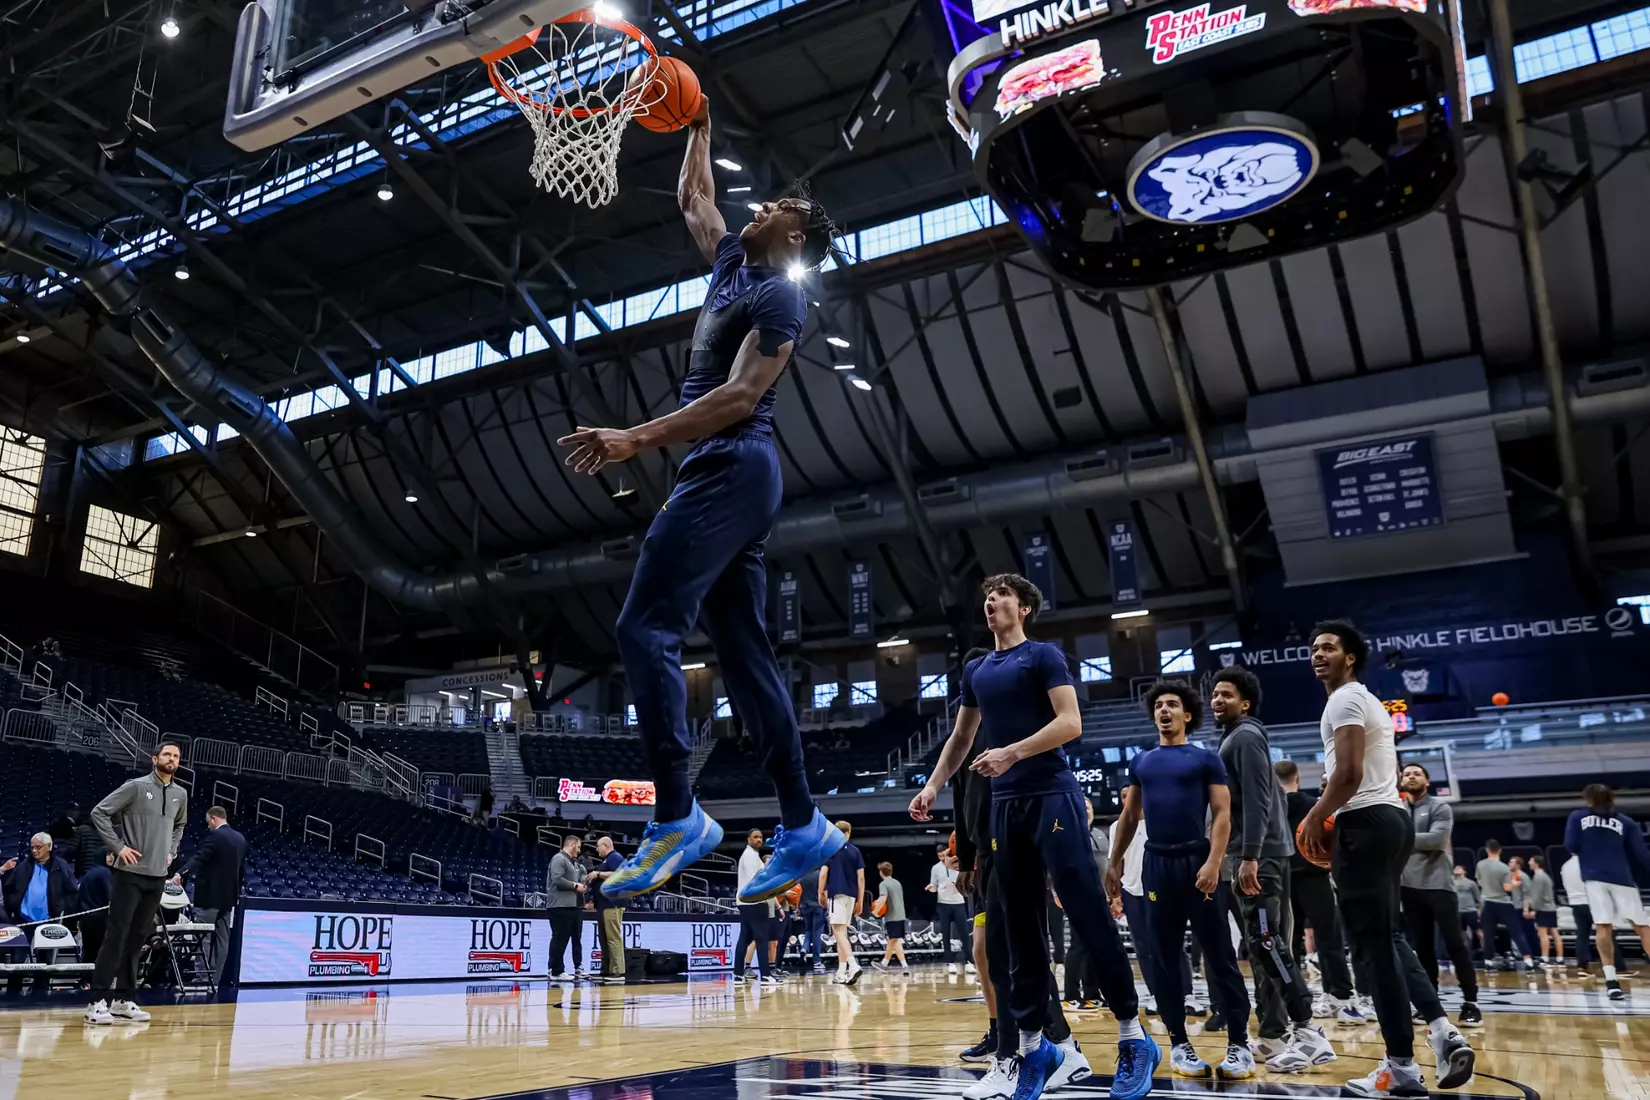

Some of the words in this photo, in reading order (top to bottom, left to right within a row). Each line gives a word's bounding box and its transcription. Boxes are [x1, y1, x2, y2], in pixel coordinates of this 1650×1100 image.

[1149, 7, 1207, 45] PENN
[1157, 9, 1243, 61] STATION
[1202, 27, 1234, 44] COAST
[1377, 631, 1450, 652] HINKLE
[1456, 616, 1599, 645] FIELDHOUSE
[442, 671, 509, 687] CONCESSIONS
[82, 735, 99, 747] 206
[1581, 815, 1623, 835] BUTLER
[314, 915, 393, 950] HOPE
[470, 919, 532, 950] HOPE
[592, 923, 642, 949] HPE
[691, 924, 732, 948] HOPE
[309, 966, 351, 975] PLUMBING
[468, 964, 500, 972] PLUMBING
